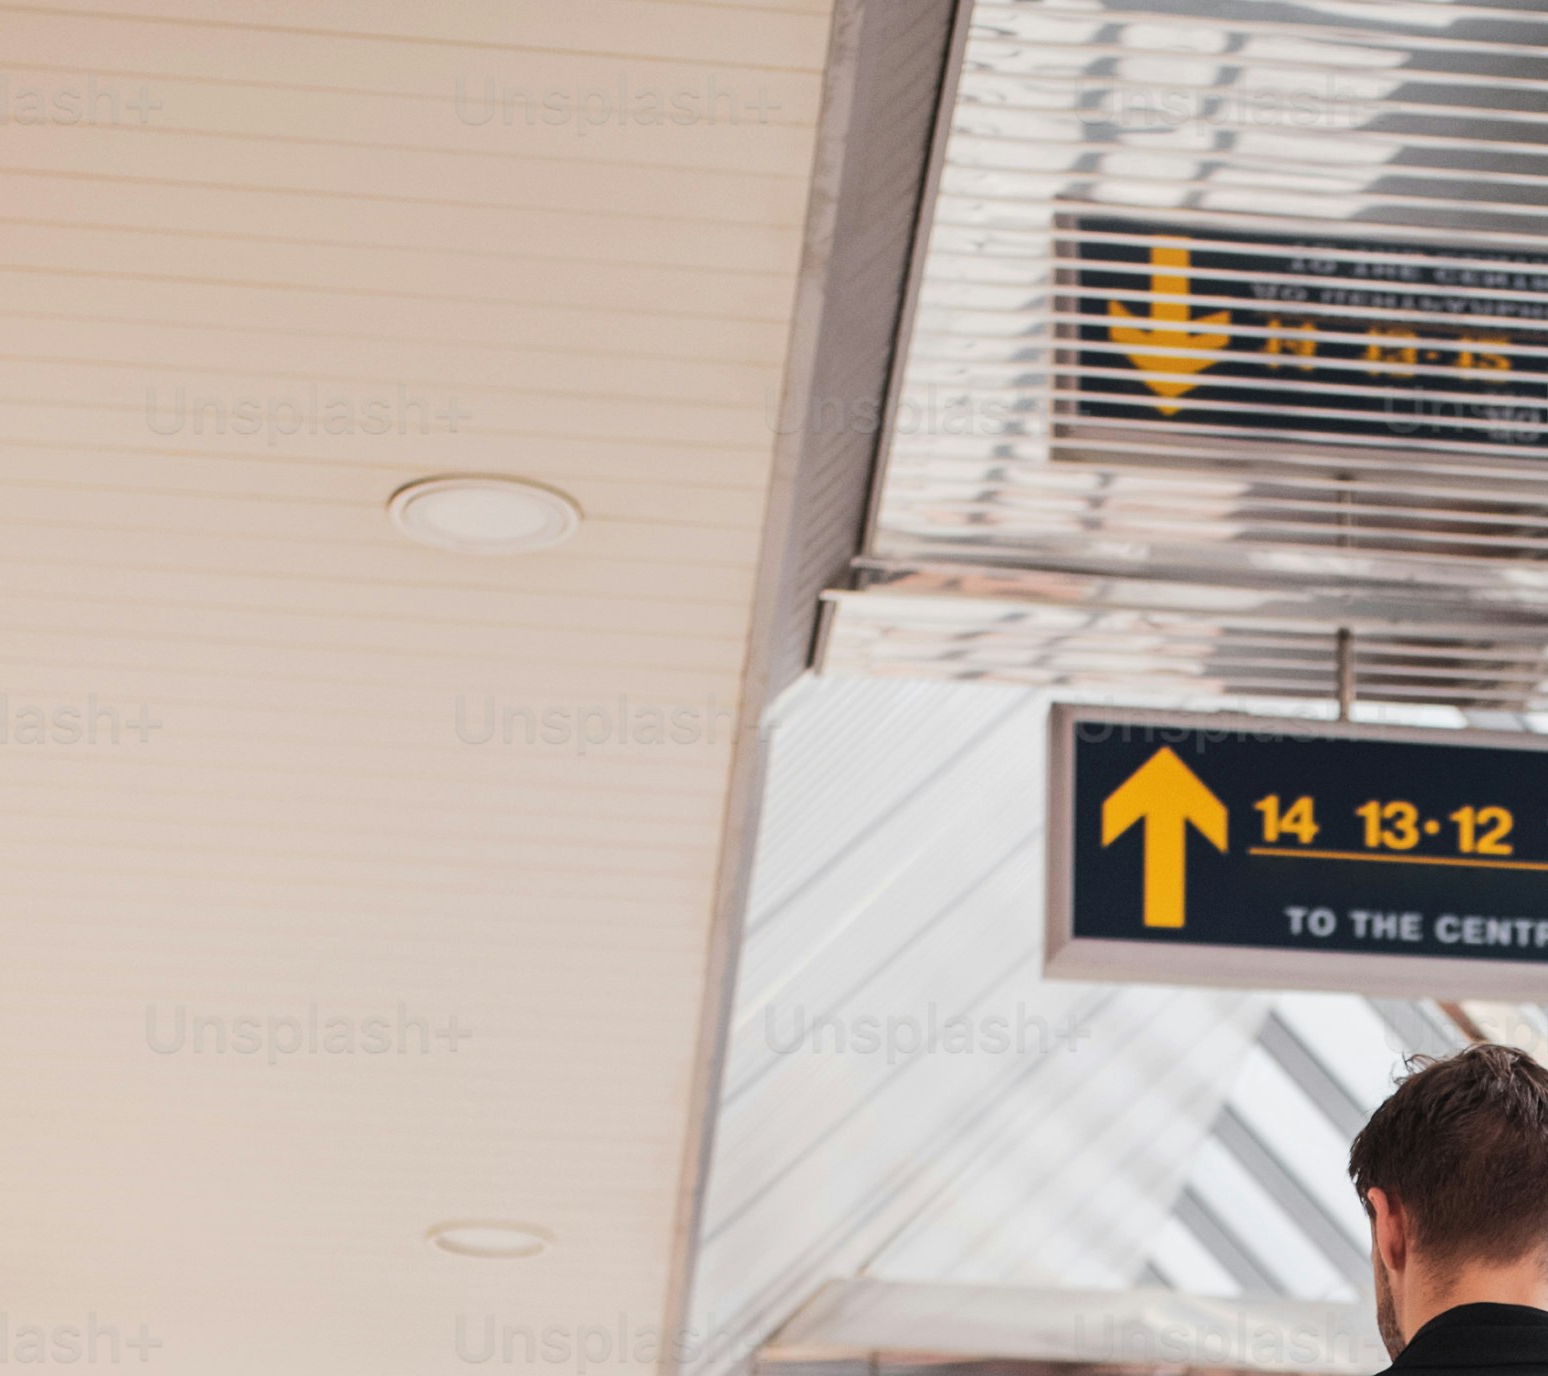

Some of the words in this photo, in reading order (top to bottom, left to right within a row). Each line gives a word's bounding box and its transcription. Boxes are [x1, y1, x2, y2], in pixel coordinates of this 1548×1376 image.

[1254, 794, 1319, 844] 14
[1285, 906, 1336, 937] TO
[1349, 910, 1422, 941] THE
